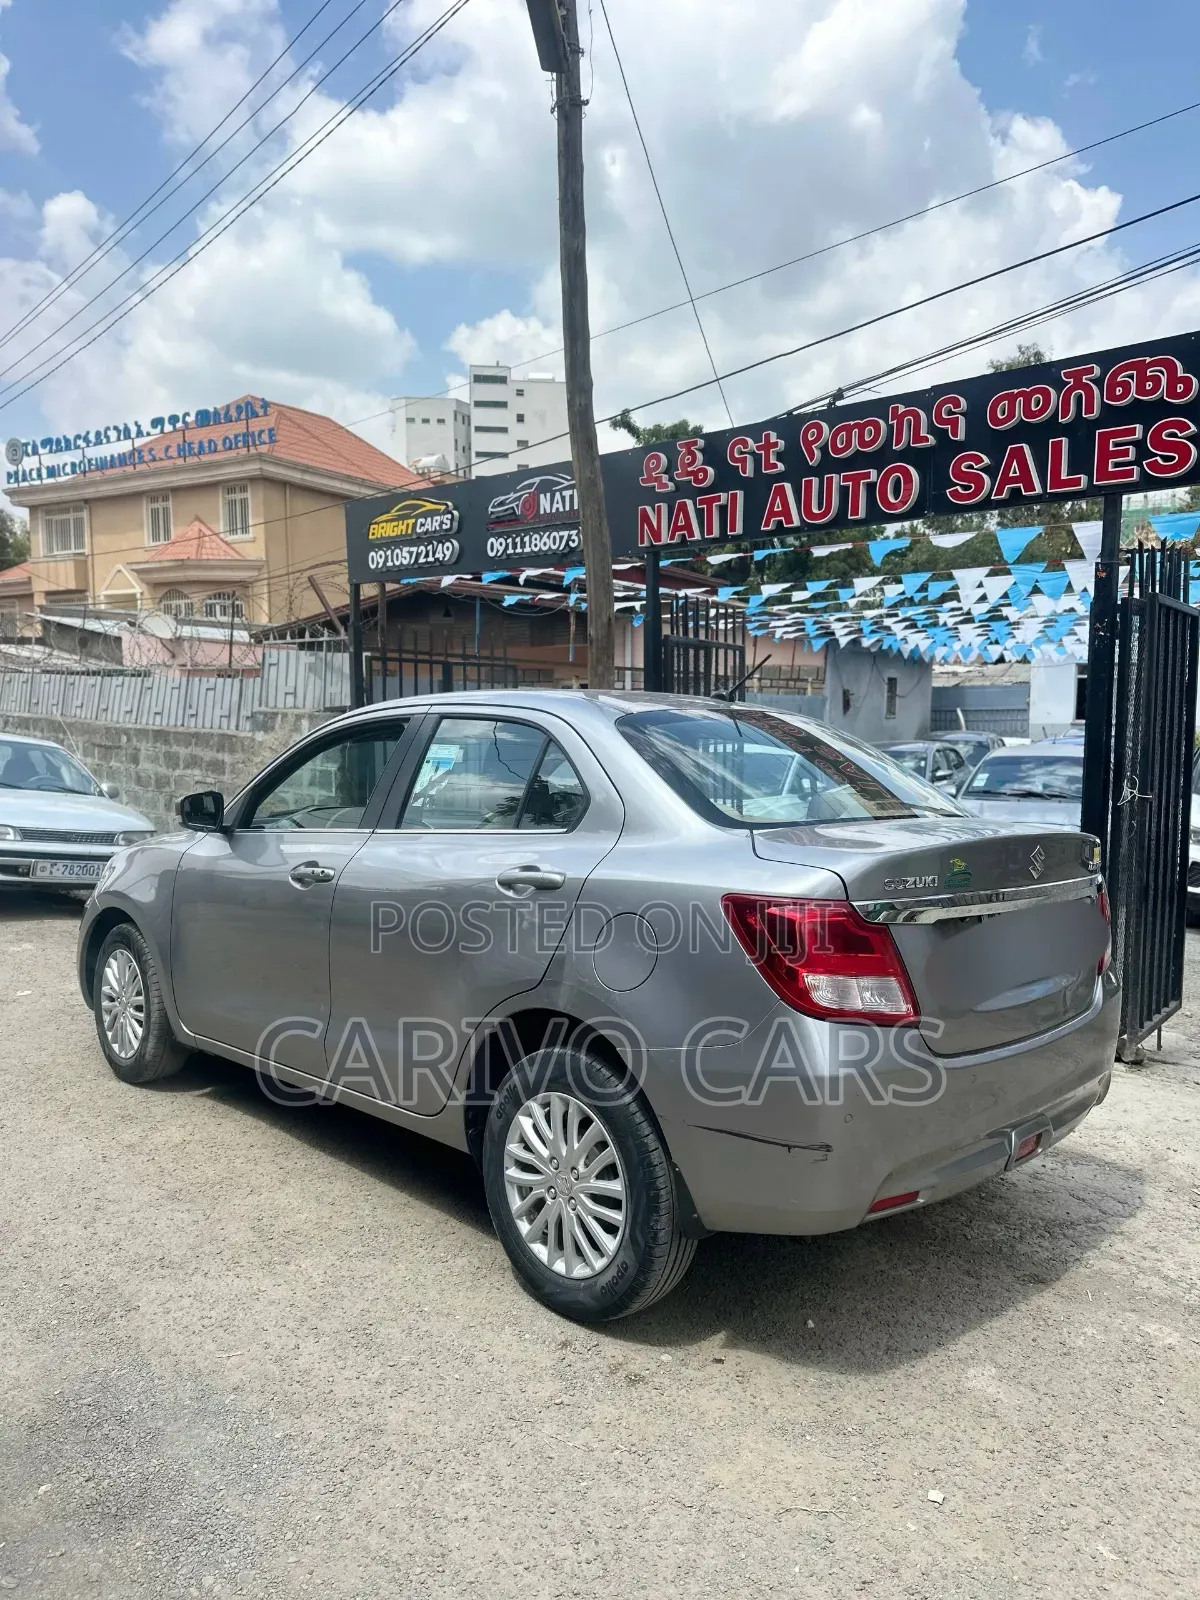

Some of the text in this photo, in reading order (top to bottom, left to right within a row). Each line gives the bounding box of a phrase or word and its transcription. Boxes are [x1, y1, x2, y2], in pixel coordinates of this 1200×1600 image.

[727, 431, 785, 477] ናቲ
[800, 394, 967, 466] የመኪና
[987, 355, 1199, 430] መሸጫ
[6, 467, 43, 484] PEACE
[46, 449, 144, 478] MICROFINANCE
[176, 438, 218, 457] HEAD
[221, 426, 276, 451] OFFICE
[638, 417, 1198, 547] NATI AUTO SALES
[540, 489, 579, 515] NATI
[369, 514, 452, 539] BRIGHT CAR'S
[368, 541, 453, 569] 0910572149
[487, 529, 579, 557] 0911186073
[884, 875, 939, 891] SUZUKI
